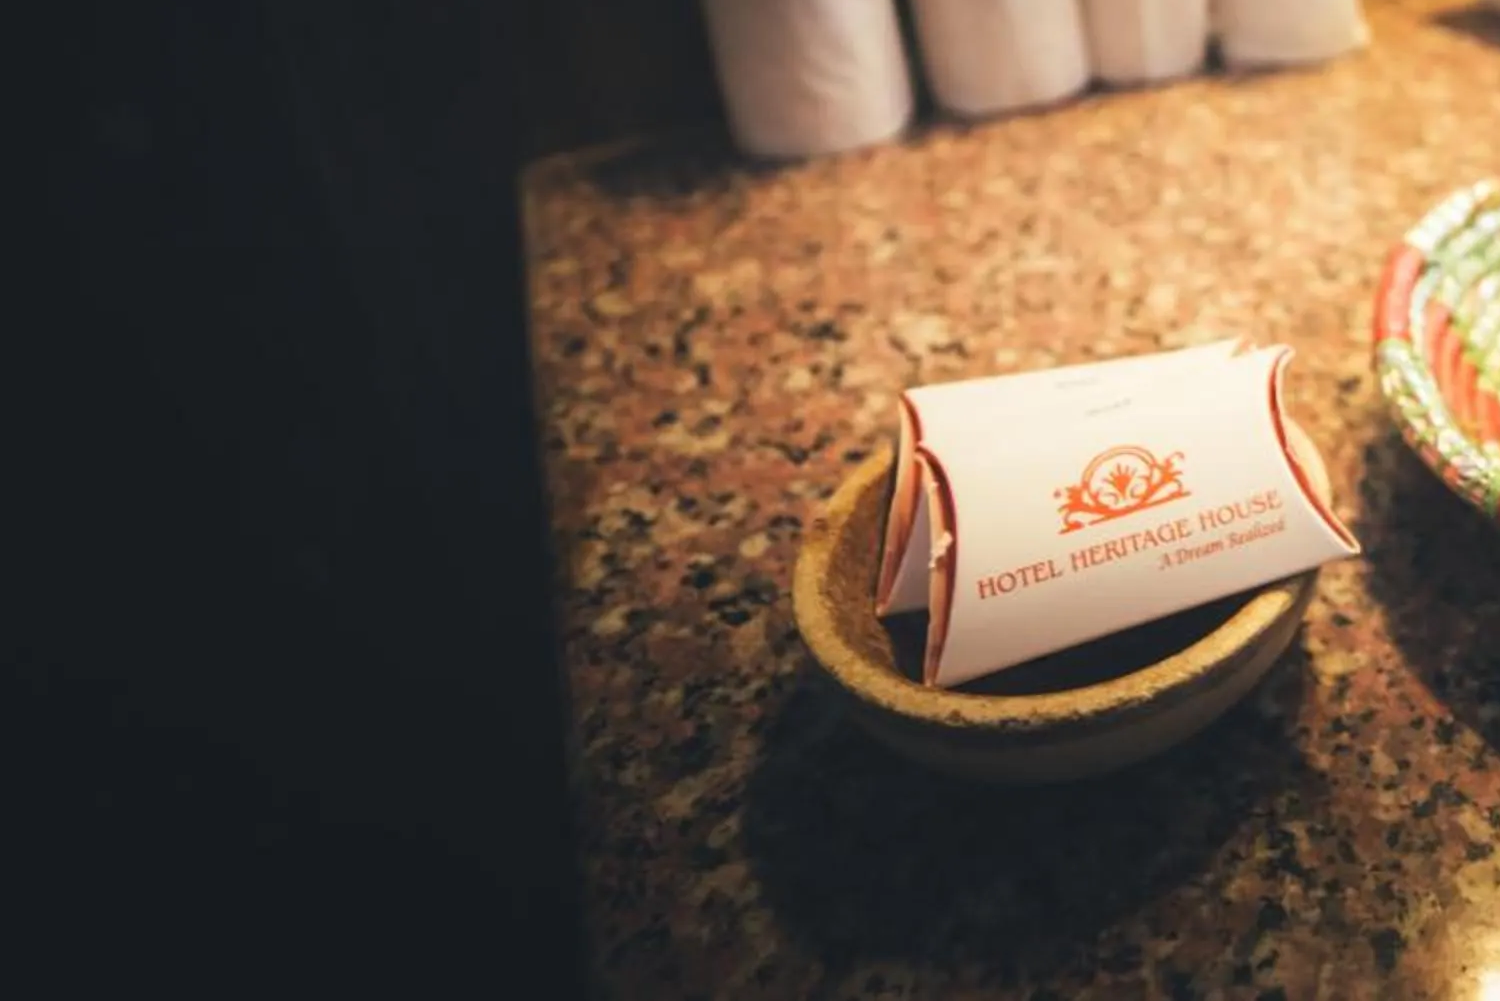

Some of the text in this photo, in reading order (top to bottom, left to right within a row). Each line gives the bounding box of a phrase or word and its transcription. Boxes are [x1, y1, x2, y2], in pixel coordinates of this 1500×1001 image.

[977, 489, 1283, 599] HOTEL HERITAGE HOUSE
[1158, 515, 1286, 571] A Dream Realized
